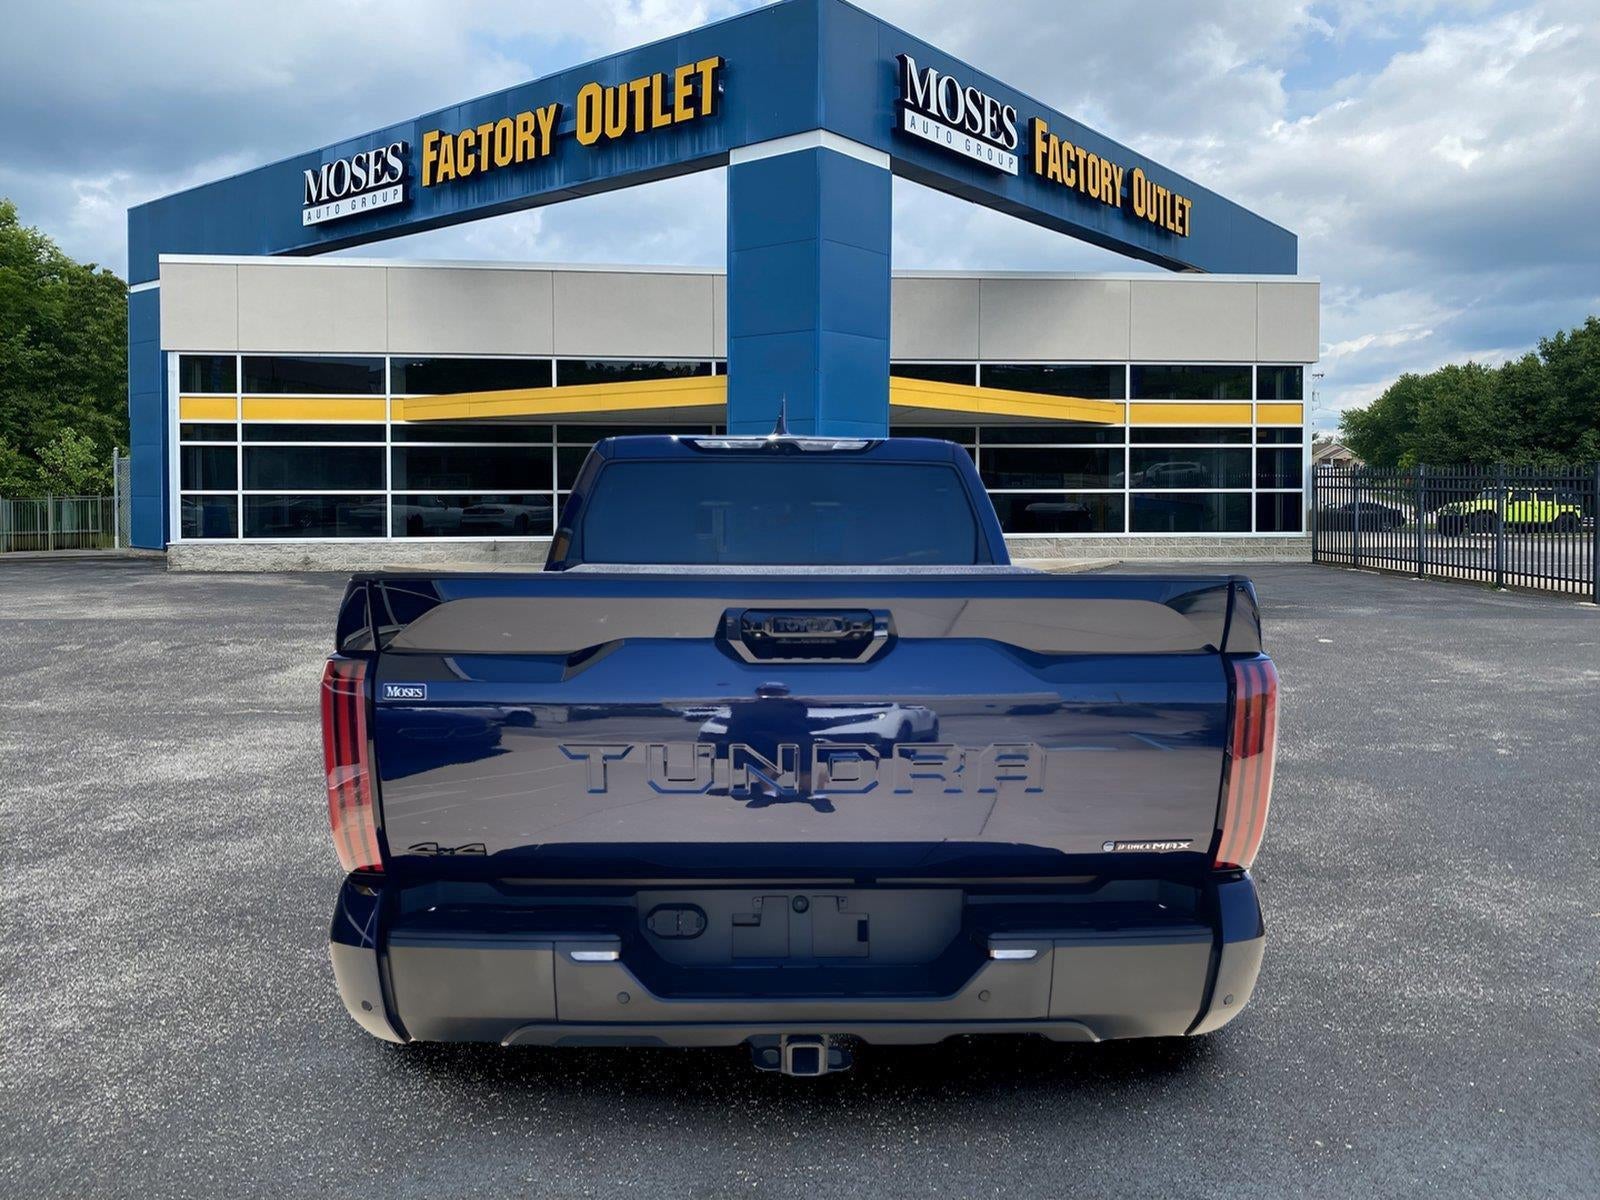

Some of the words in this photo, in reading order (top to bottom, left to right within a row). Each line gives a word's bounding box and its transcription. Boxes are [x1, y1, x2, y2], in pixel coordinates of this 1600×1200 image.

[421, 102, 560, 187] FACTORY
[575, 56, 721, 146] OUTLET
[900, 53, 1019, 150] MOSES
[909, 115, 953, 145] AUTO
[965, 138, 1014, 169] GROUP
[303, 142, 403, 205] MOSES
[1033, 117, 1124, 208] FACTORY
[1131, 167, 1192, 237] OUTLET
[306, 201, 341, 222] AUTO
[350, 189, 399, 211] GROUP
[386, 686, 423, 697] MOSES
[558, 743, 1047, 795] TUNDRA
